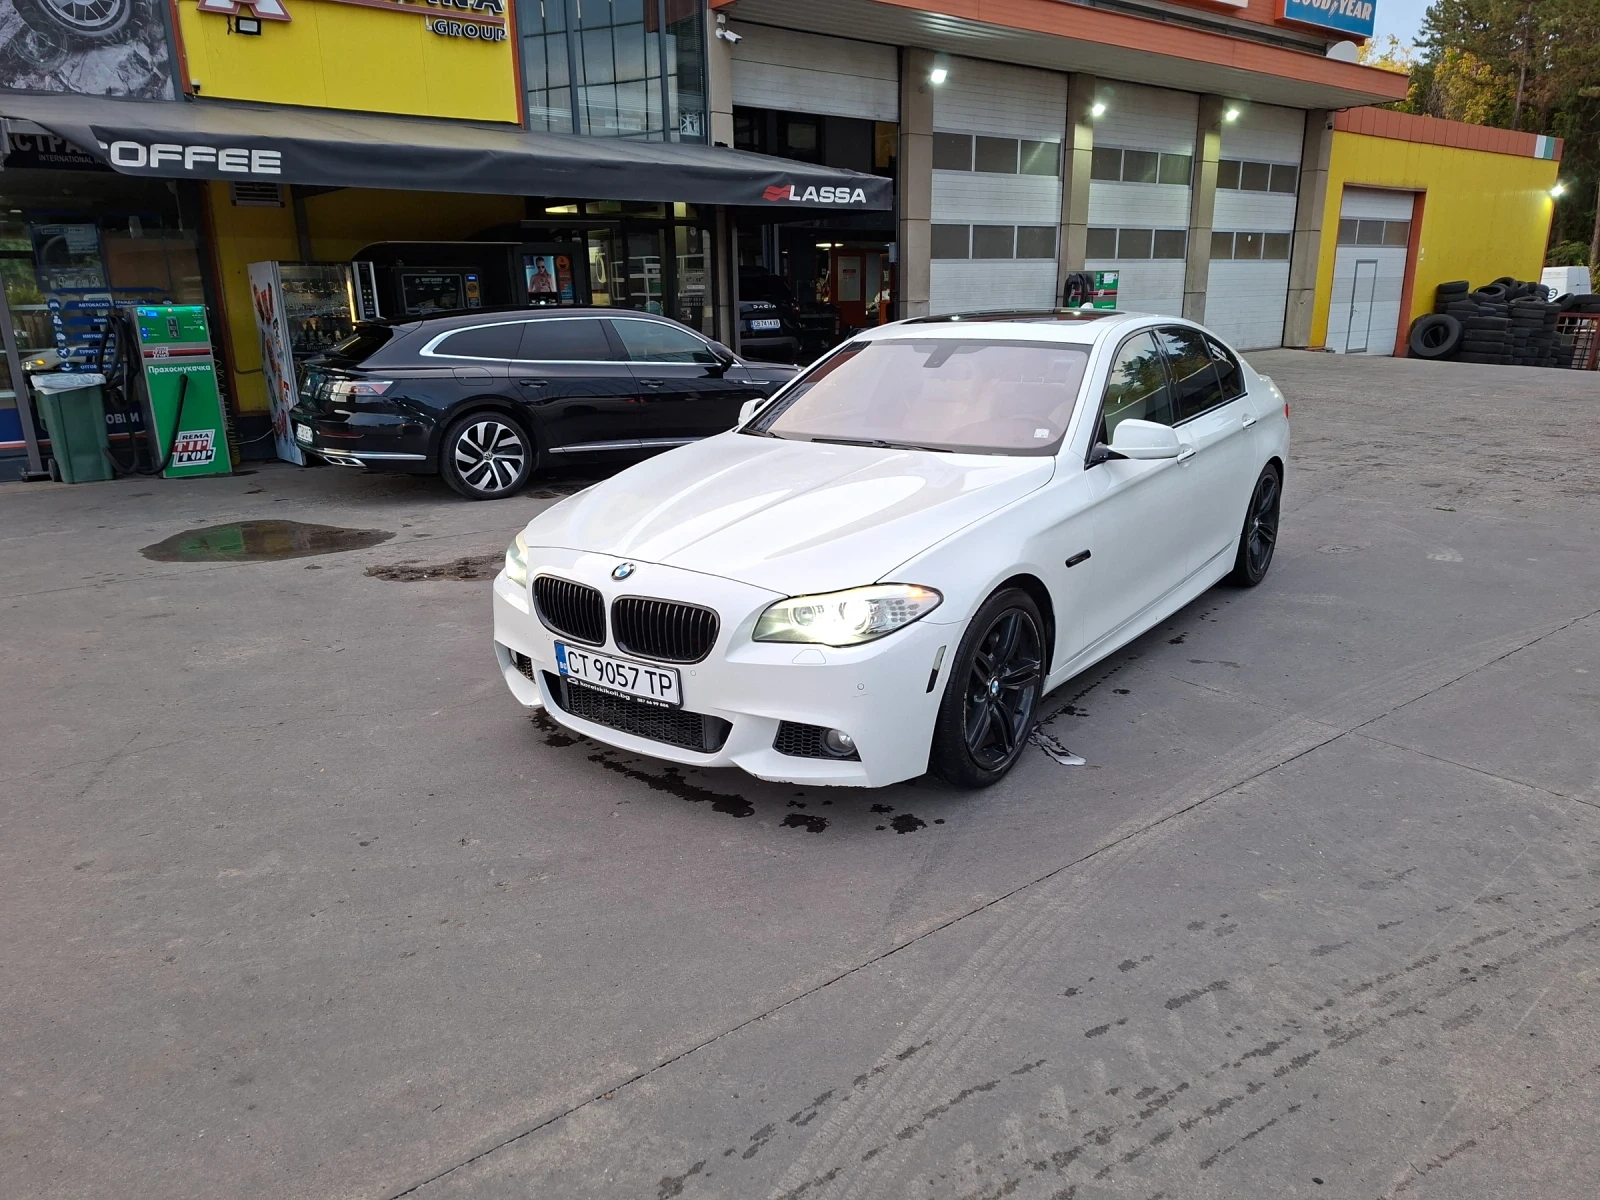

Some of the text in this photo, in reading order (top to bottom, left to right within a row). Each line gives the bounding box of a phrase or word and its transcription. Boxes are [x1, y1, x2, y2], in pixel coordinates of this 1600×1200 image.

[433, 18, 506, 41] GROUP
[38, 154, 93, 163] INTERNATIONAL
[99, 140, 281, 174] OFFEE
[789, 185, 867, 203] LASSA
[148, 364, 211, 375] Прахосмукачка
[174, 440, 209, 451] TIP
[180, 450, 213, 461] TOP
[567, 651, 672, 697] CT 9057 TP
[579, 681, 631, 701] koreiskikoli.bg
